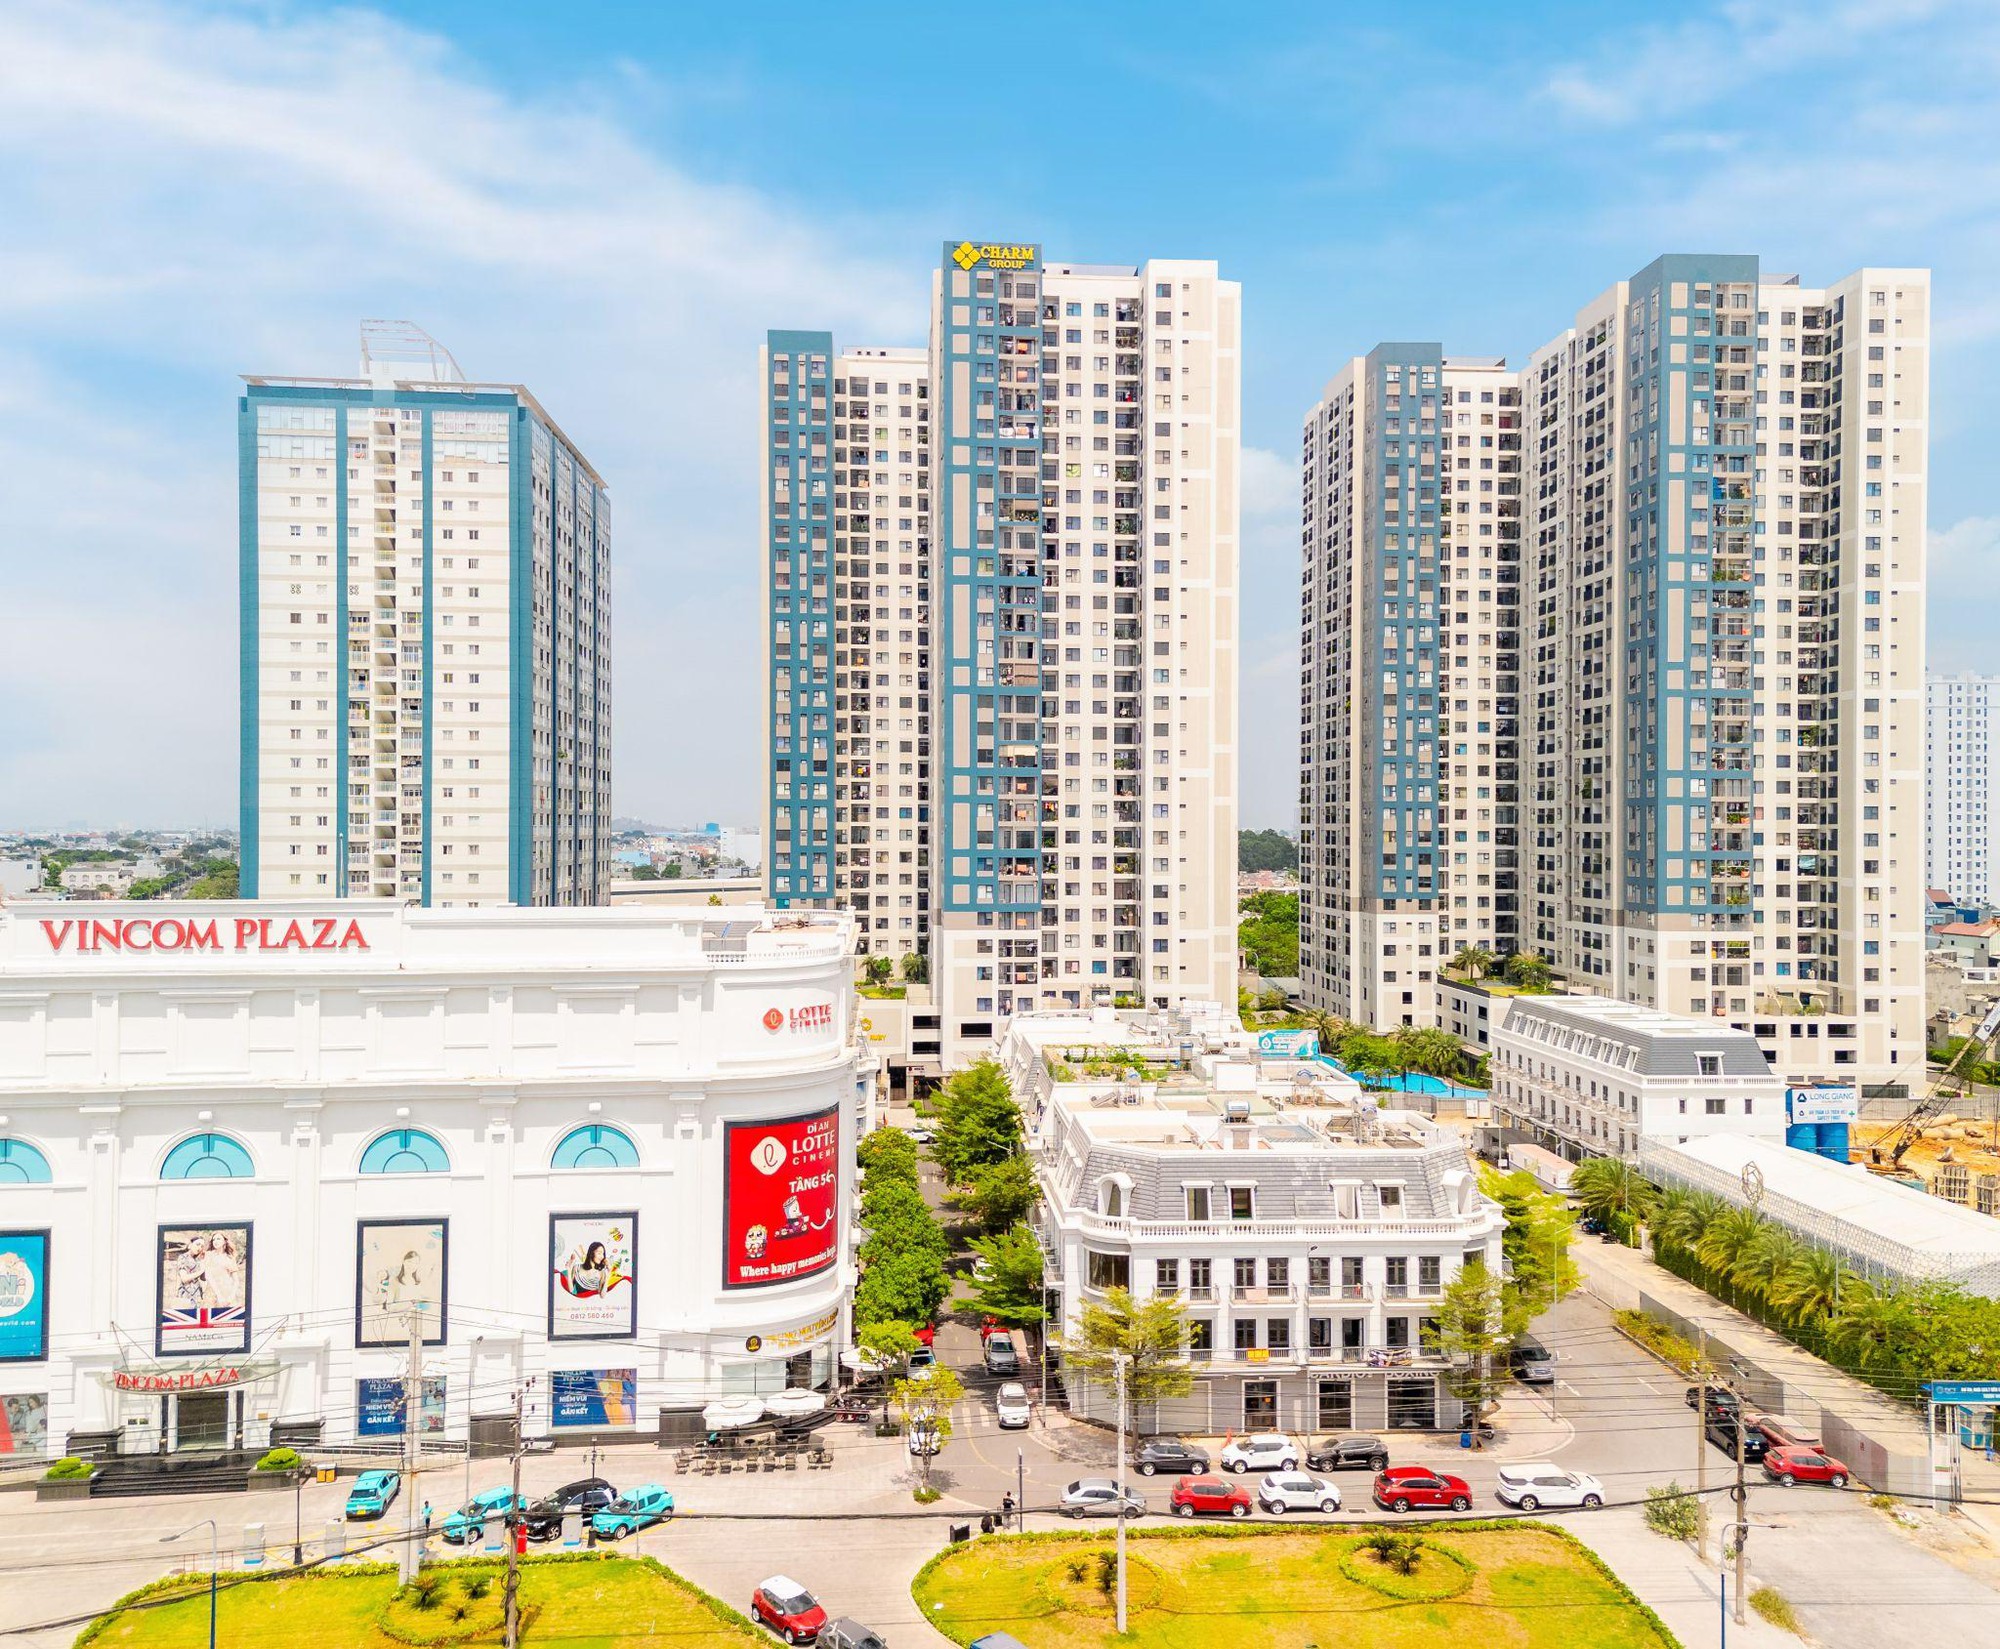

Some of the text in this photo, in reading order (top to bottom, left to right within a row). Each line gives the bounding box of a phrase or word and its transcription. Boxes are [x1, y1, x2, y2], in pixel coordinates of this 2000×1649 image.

[980, 245, 1034, 260] CHARM
[988, 259, 1026, 269] GROUP
[39, 918, 371, 951] VINCOM PLAZA
[789, 1003, 832, 1020] LOTTE
[789, 1016, 831, 1029] CINEMA
[1831, 1092, 1855, 1100] GIANG
[818, 1120, 829, 1132] AN
[792, 1129, 835, 1154] LOTTE
[740, 1265, 769, 1277] Where
[770, 1262, 797, 1275] happy
[797, 1251, 827, 1268] memories
[179, 1367, 239, 1389] PLAZA
